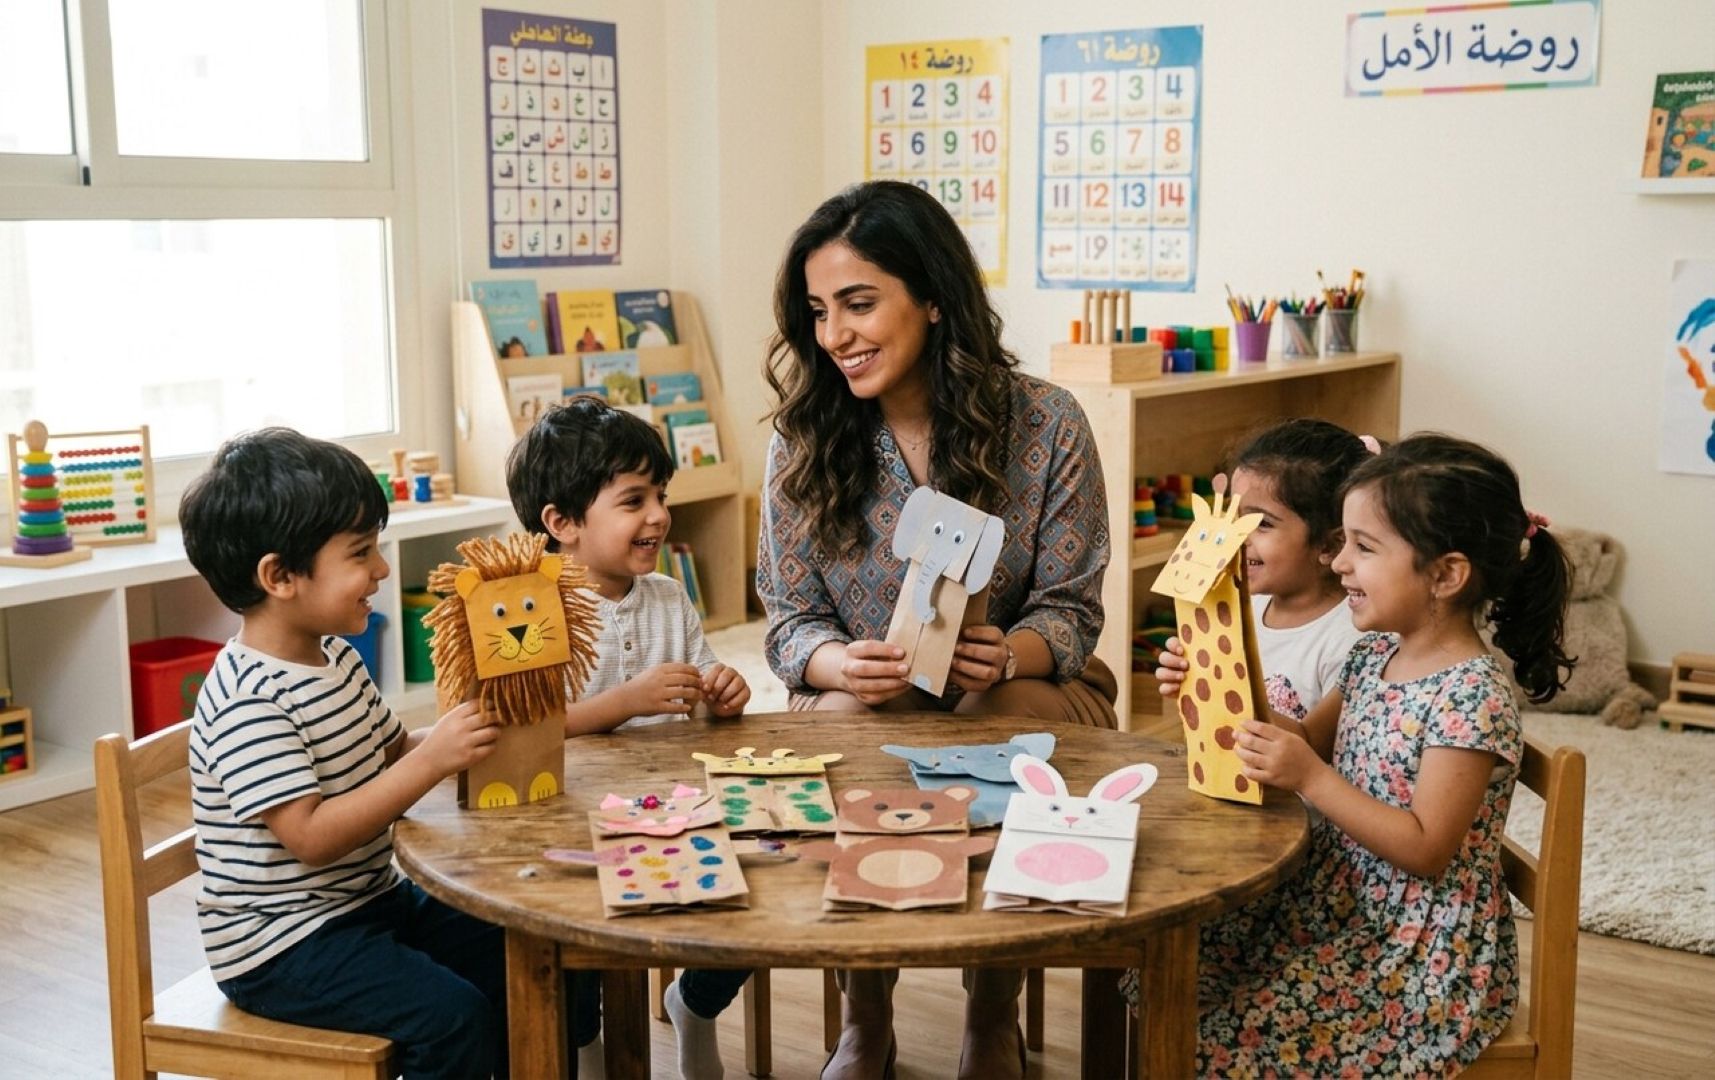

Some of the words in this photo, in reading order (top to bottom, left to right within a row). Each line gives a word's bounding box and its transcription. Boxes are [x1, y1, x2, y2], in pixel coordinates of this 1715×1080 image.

[926, 48, 974, 74] روضة
[1104, 34, 1161, 67] روضة
[1362, 21, 1453, 81] الأمل
[1467, 23, 1580, 72] روضة
[882, 85, 890, 108] 1
[912, 83, 926, 108] 2
[944, 82, 959, 107] 3
[978, 80, 992, 105] 4
[1059, 78, 1067, 104] 1
[1091, 76, 1106, 102] 2
[1128, 75, 1144, 100] 3
[1166, 74, 1182, 100] 4
[880, 132, 892, 156] 5
[911, 131, 925, 156] 6
[944, 130, 958, 154] 9
[972, 130, 996, 154] 10
[1054, 131, 1070, 156] 5
[1090, 130, 1106, 155] 6
[1127, 128, 1142, 154] 7
[1164, 128, 1181, 154] 8
[940, 180, 962, 203] 13
[972, 179, 996, 203] 14
[1054, 184, 1070, 208] 11
[1085, 183, 1108, 207] 12
[1122, 182, 1146, 207] 13
[1160, 182, 1185, 208] 14
[1085, 236, 1108, 260] 19
